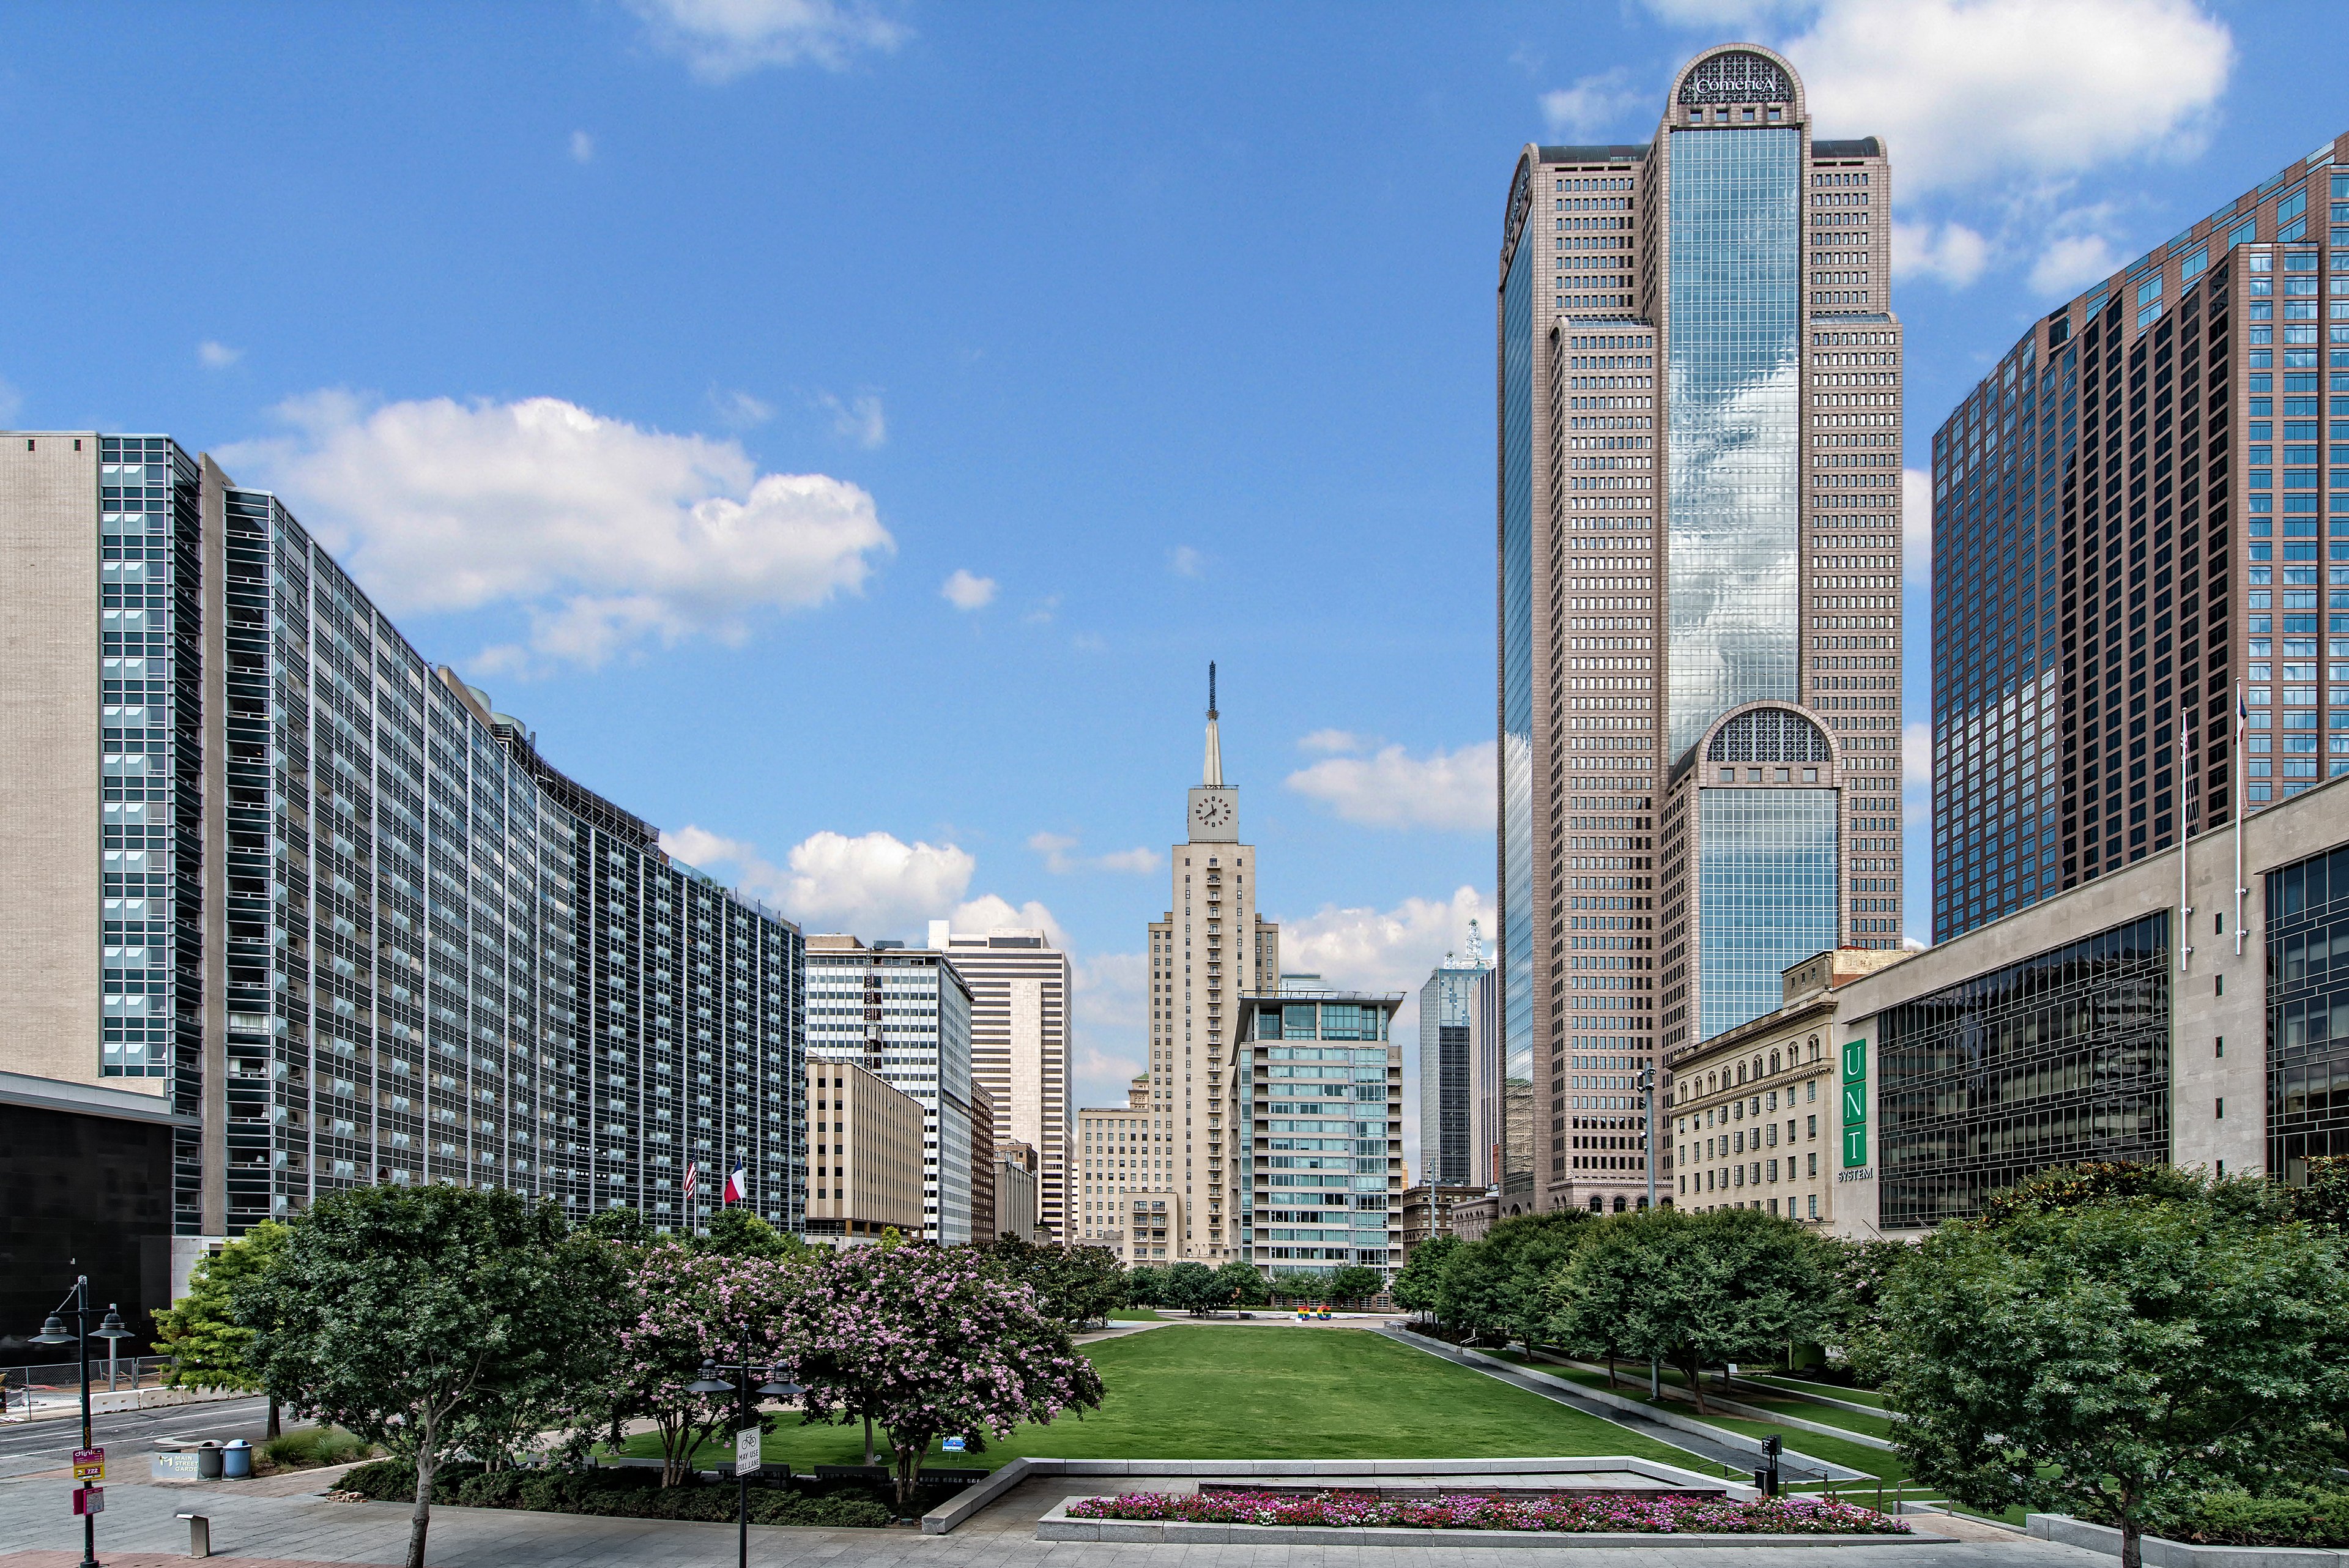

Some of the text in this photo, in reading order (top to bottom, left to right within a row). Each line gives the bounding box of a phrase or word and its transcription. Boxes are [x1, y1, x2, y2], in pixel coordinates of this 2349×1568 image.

[1846, 1046, 1861, 1159] UNT
[1838, 1167, 1873, 1182] SYSTEM
[739, 1452, 748, 1462] MAY
[738, 1458, 759, 1471] FULL LANE
